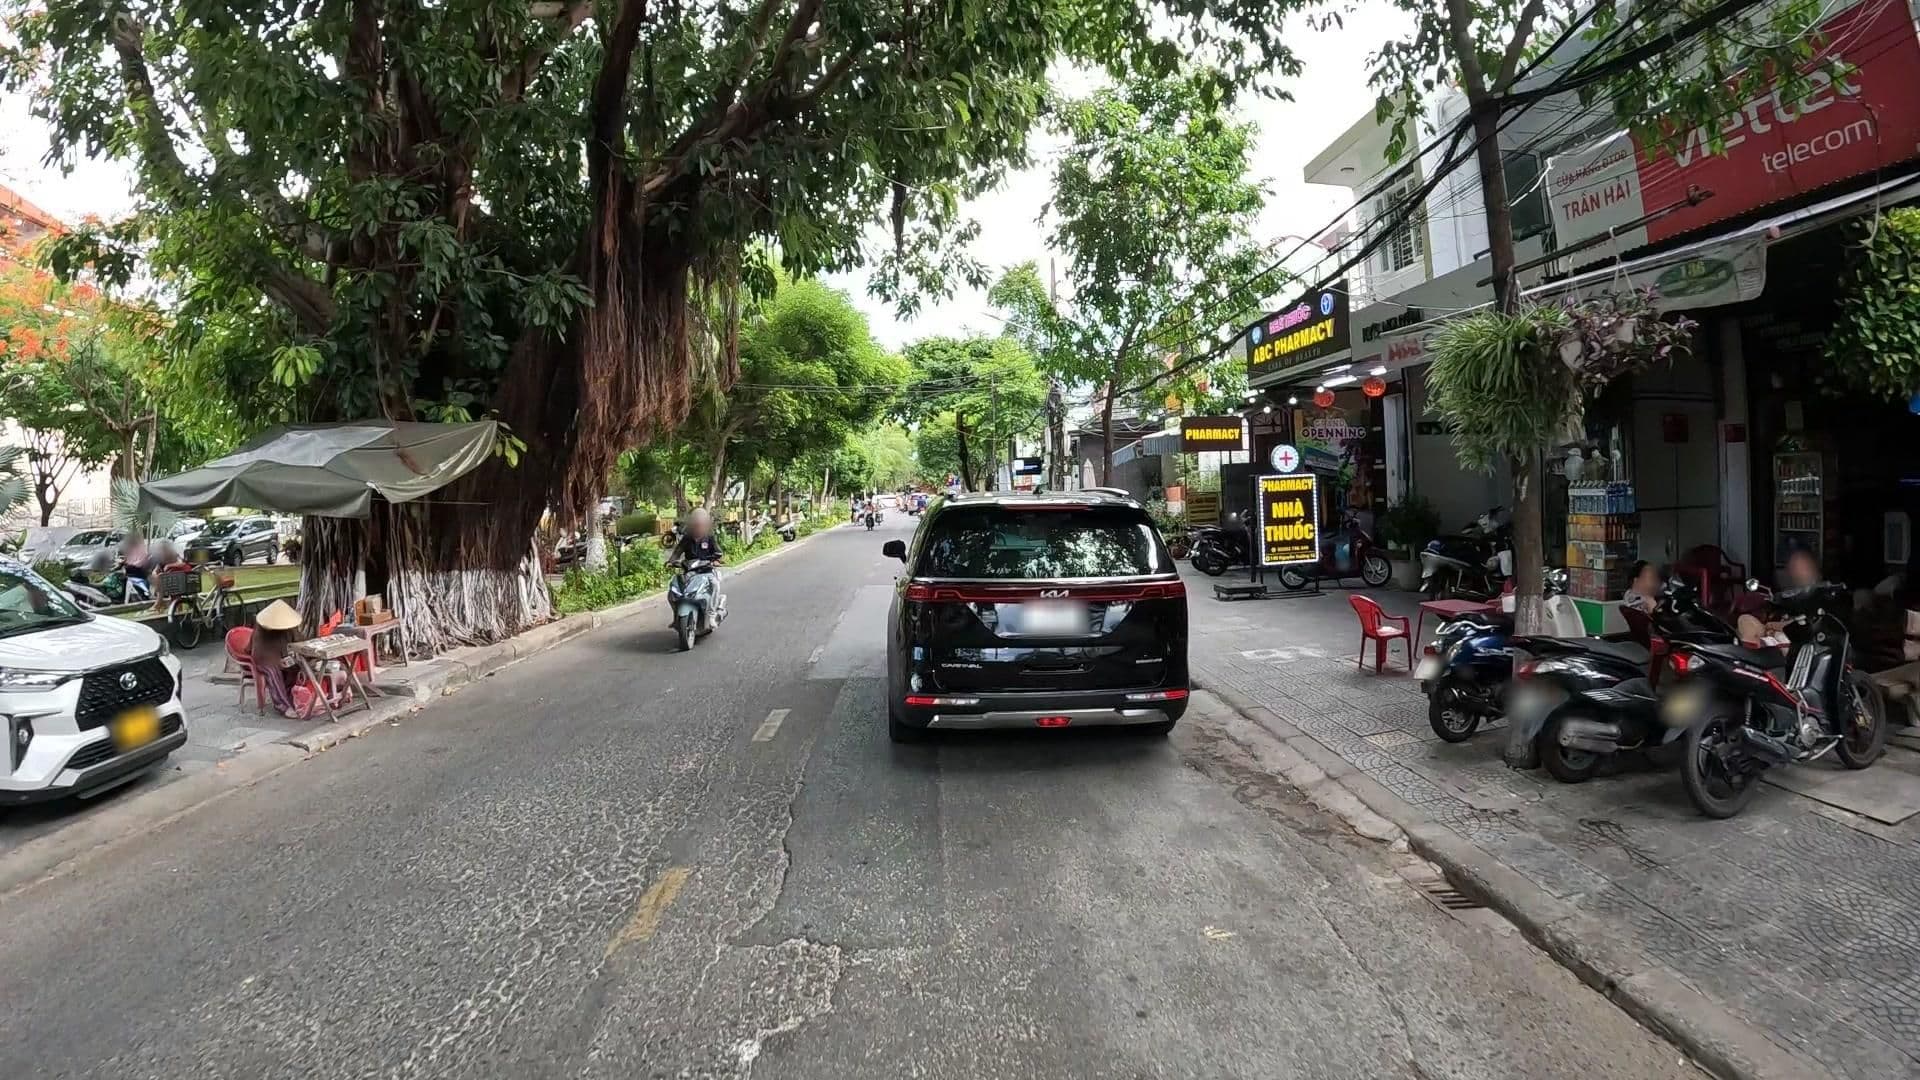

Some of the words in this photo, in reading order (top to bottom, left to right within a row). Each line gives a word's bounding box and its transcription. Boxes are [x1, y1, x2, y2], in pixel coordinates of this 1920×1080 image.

[1761, 118, 1873, 173] telecom
[1604, 176, 1631, 206] HẢI
[1253, 344, 1273, 365] ABC
[1274, 318, 1335, 357] PHARMACY
[1185, 428, 1240, 440] PHARMACY
[1302, 426, 1366, 439] OPENNING
[1262, 479, 1313, 492] PHARMACY
[1272, 498, 1304, 518] NHÀ
[1265, 518, 1314, 542] THUỐC
